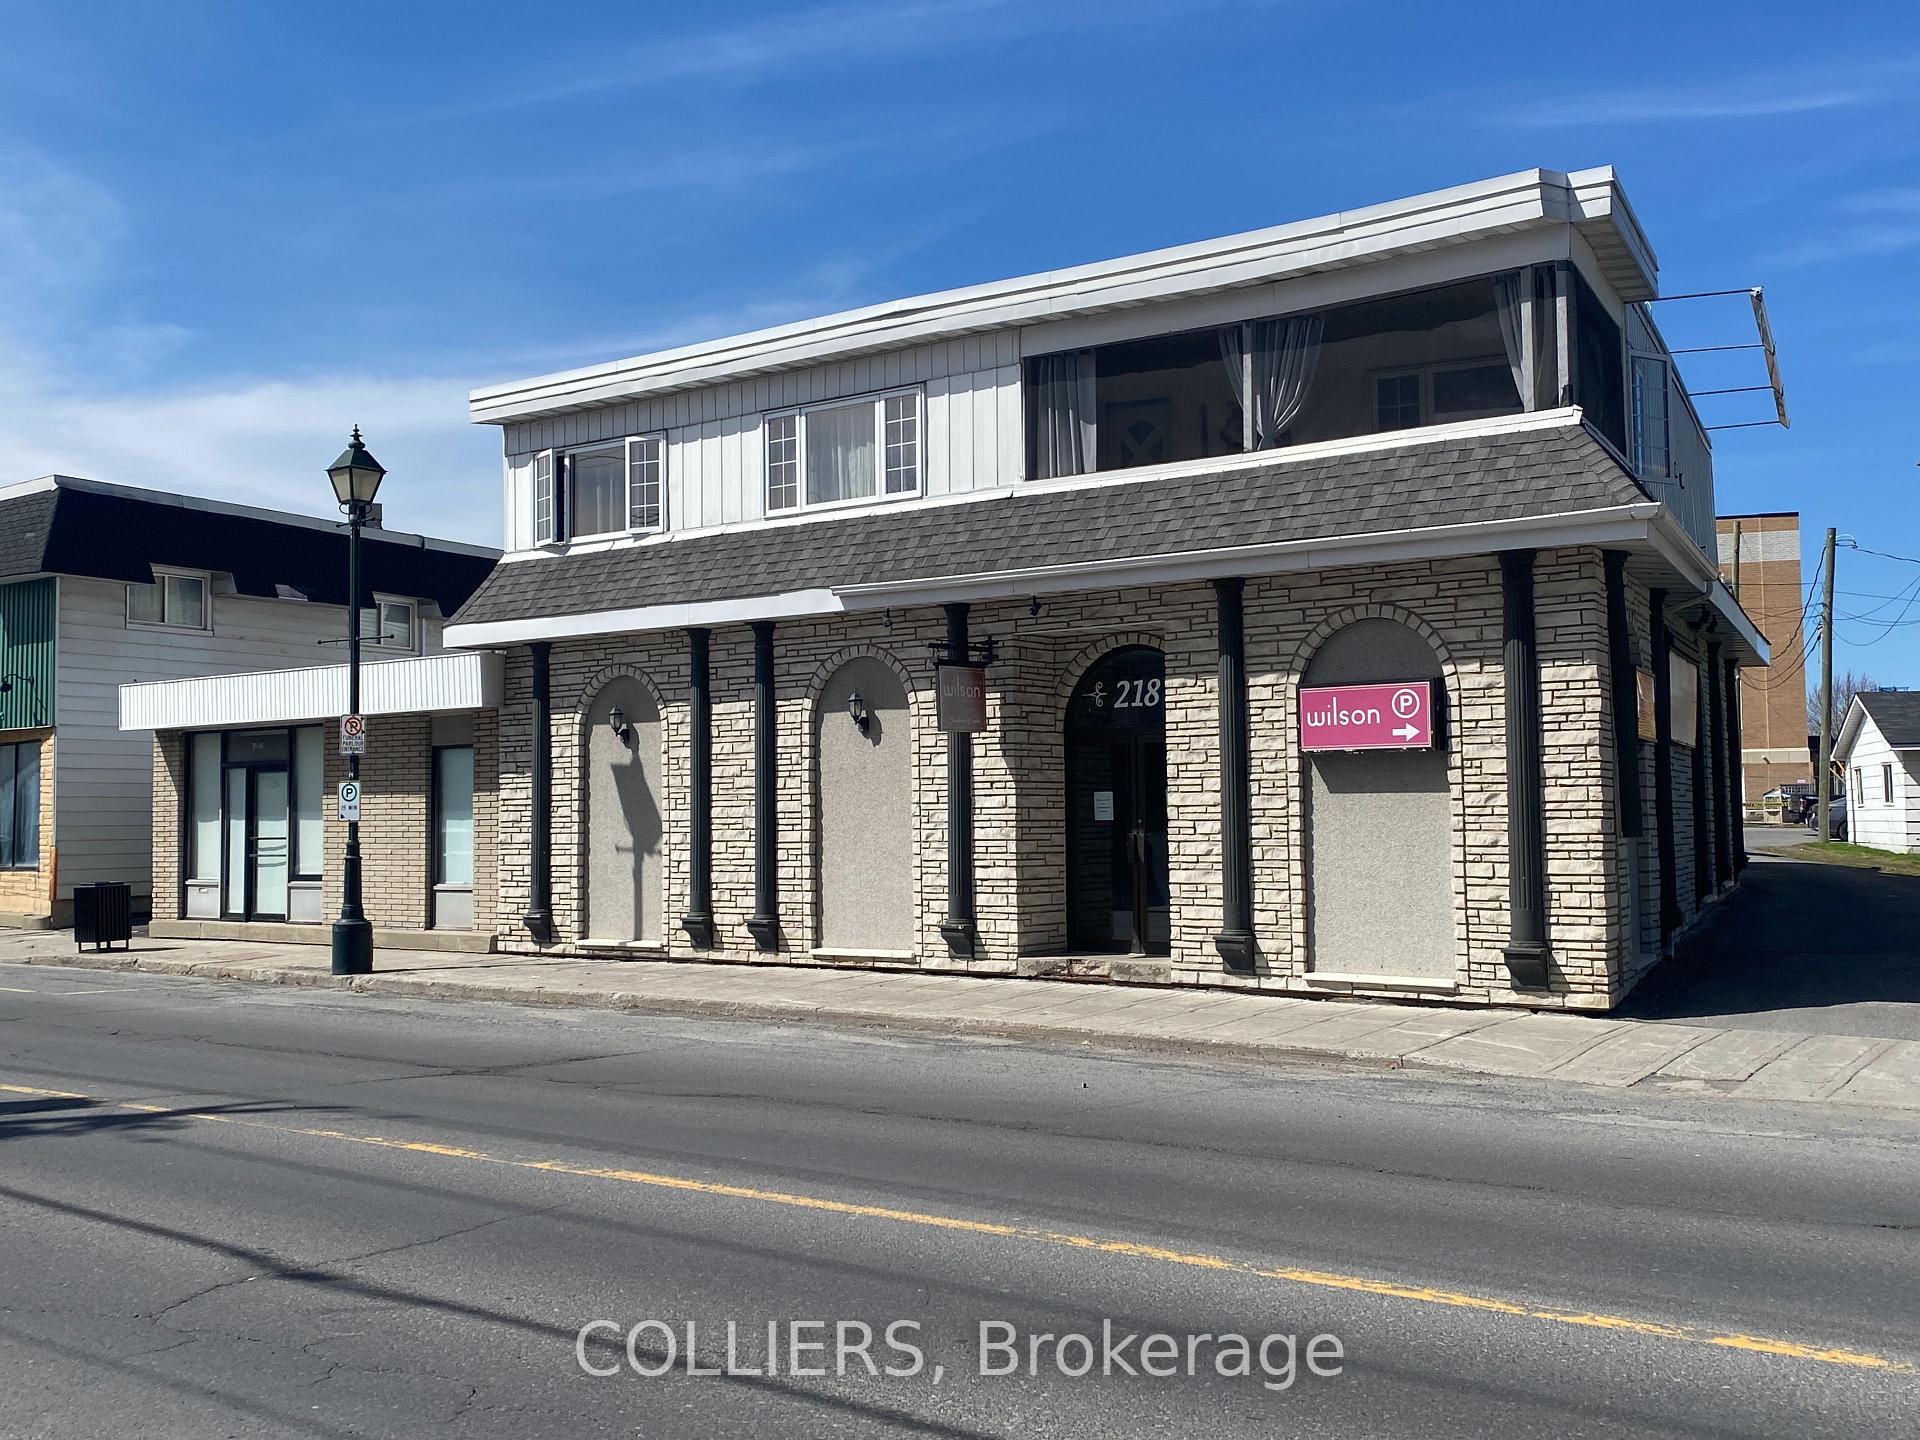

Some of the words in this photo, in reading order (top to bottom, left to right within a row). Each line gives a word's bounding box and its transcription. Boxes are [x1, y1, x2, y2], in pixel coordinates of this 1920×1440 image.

[943, 674, 981, 699] wilson
[1113, 678, 1161, 709] 218
[1306, 696, 1381, 727] wilson
[1399, 695, 1413, 713] P
